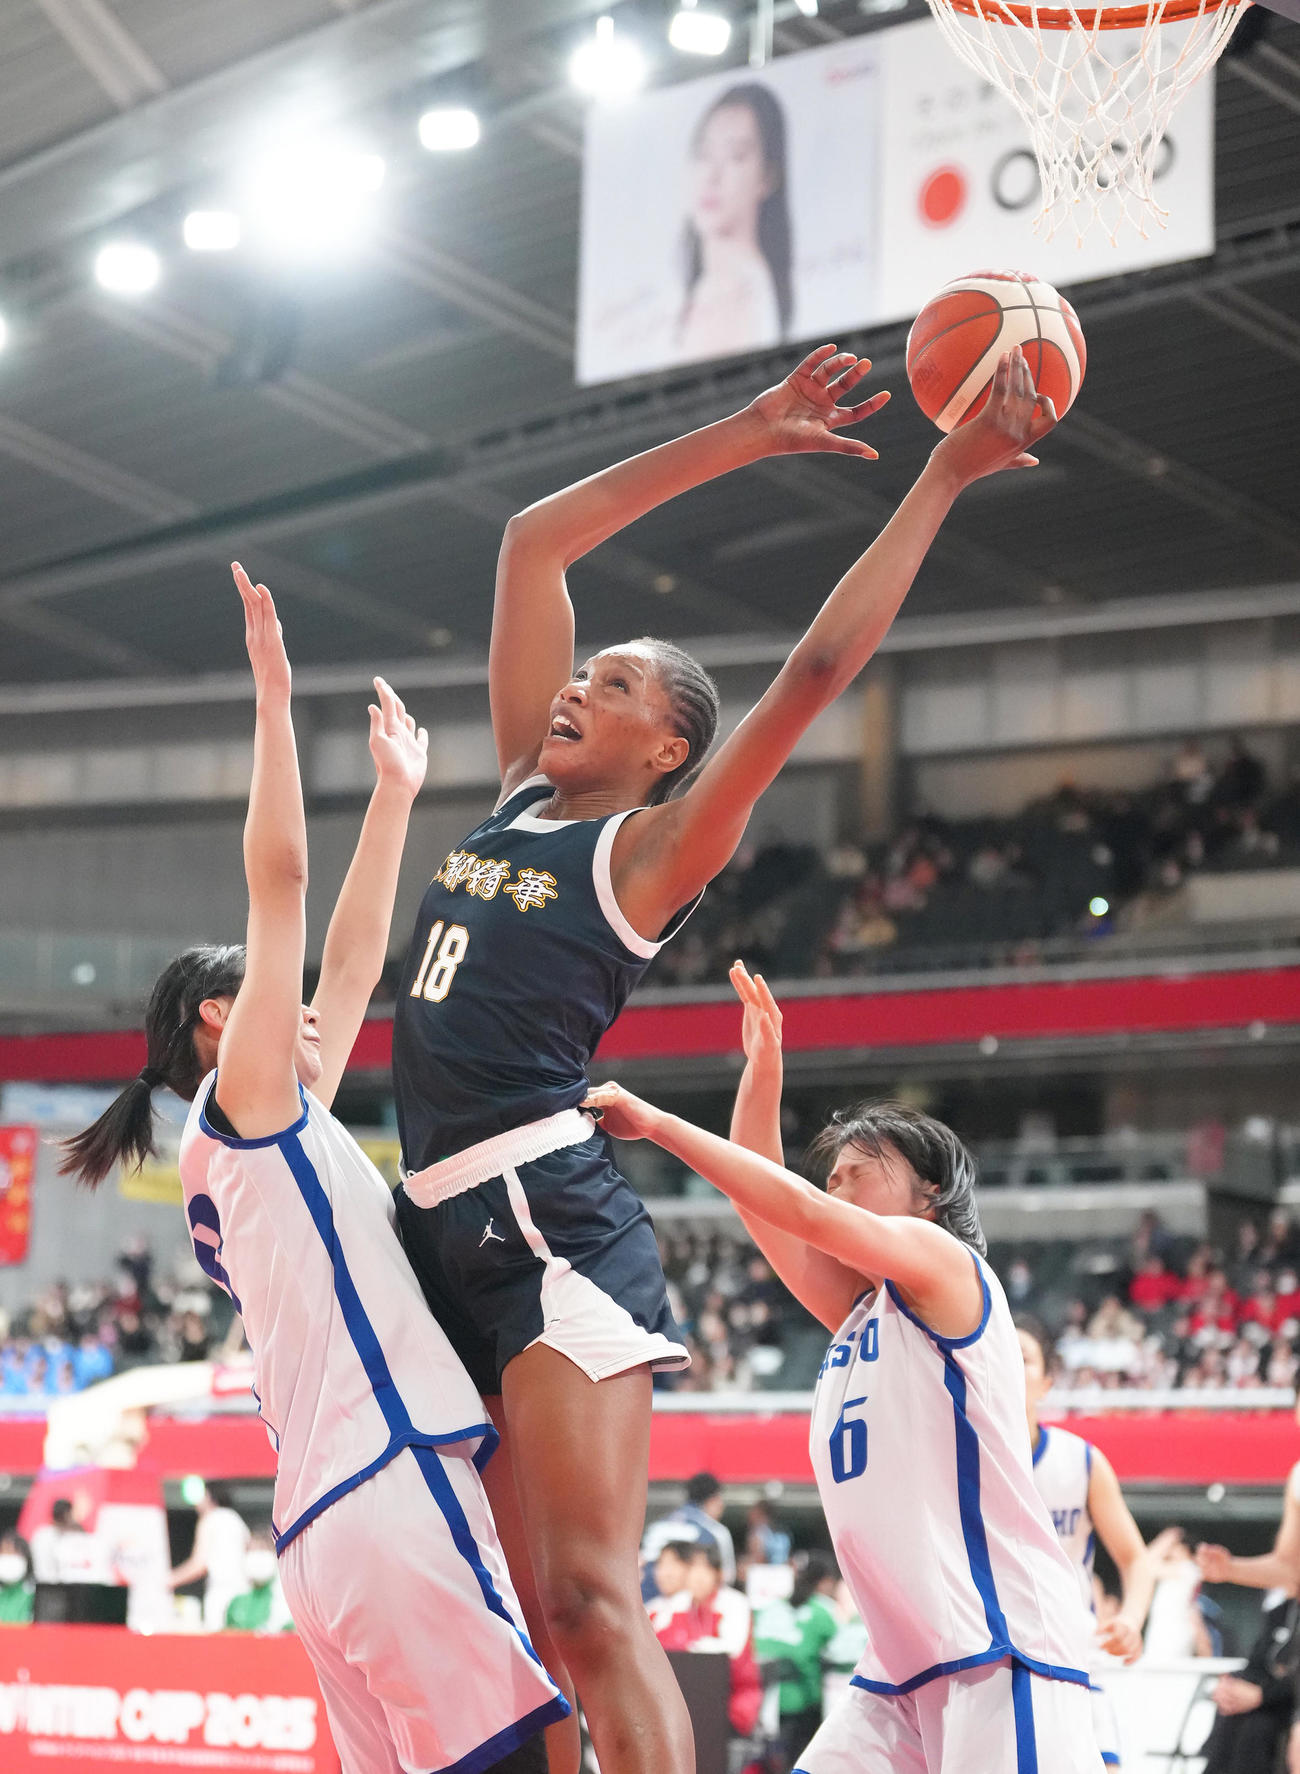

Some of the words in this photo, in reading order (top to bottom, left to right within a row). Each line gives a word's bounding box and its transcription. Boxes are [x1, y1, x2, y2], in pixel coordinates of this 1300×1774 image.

[430, 850, 558, 912] 都精華
[410, 920, 470, 1003] 18
[829, 1396, 868, 1484] 6
[120, 1687, 206, 1743] CUP
[203, 1691, 318, 1752] 2025
